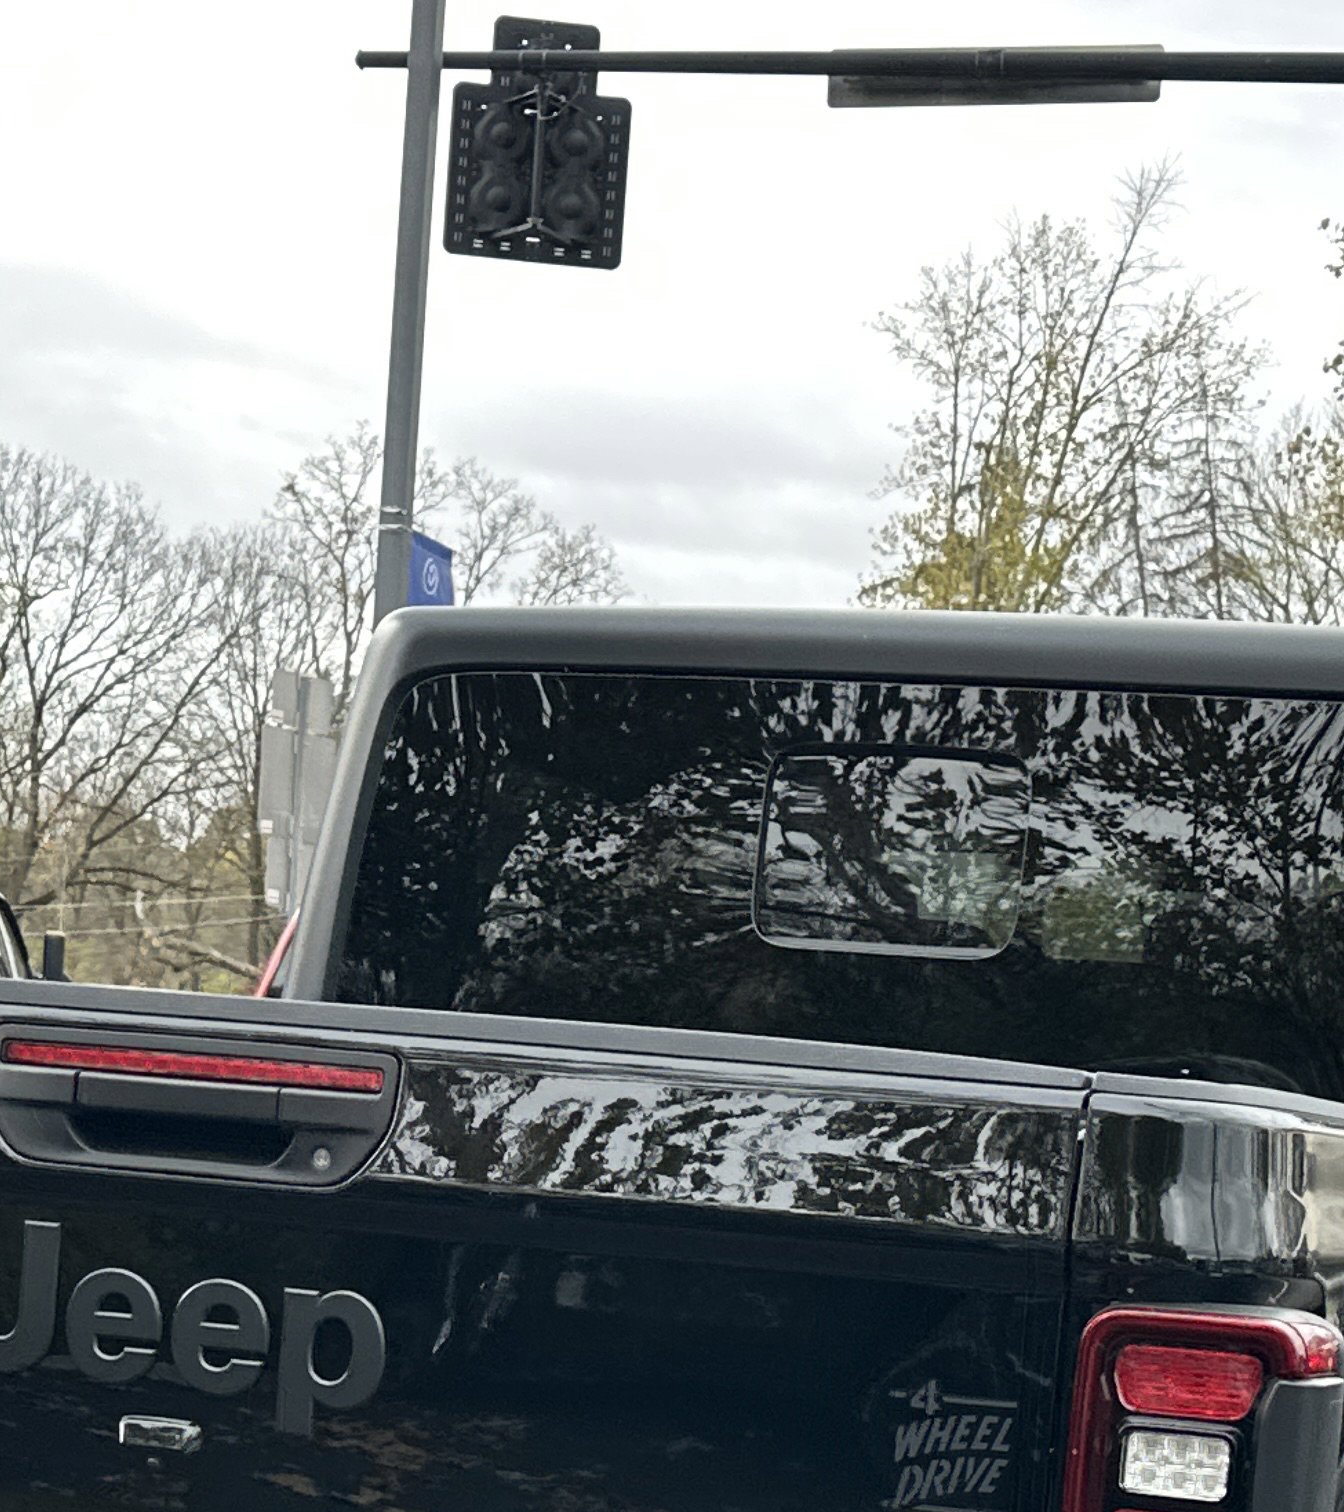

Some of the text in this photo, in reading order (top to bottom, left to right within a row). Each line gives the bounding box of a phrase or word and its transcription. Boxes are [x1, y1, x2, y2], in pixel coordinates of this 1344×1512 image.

[909, 1379, 943, 1416] 4
[894, 1415, 1014, 1463] WHEEL
[895, 1456, 1009, 1509] DRIVE
